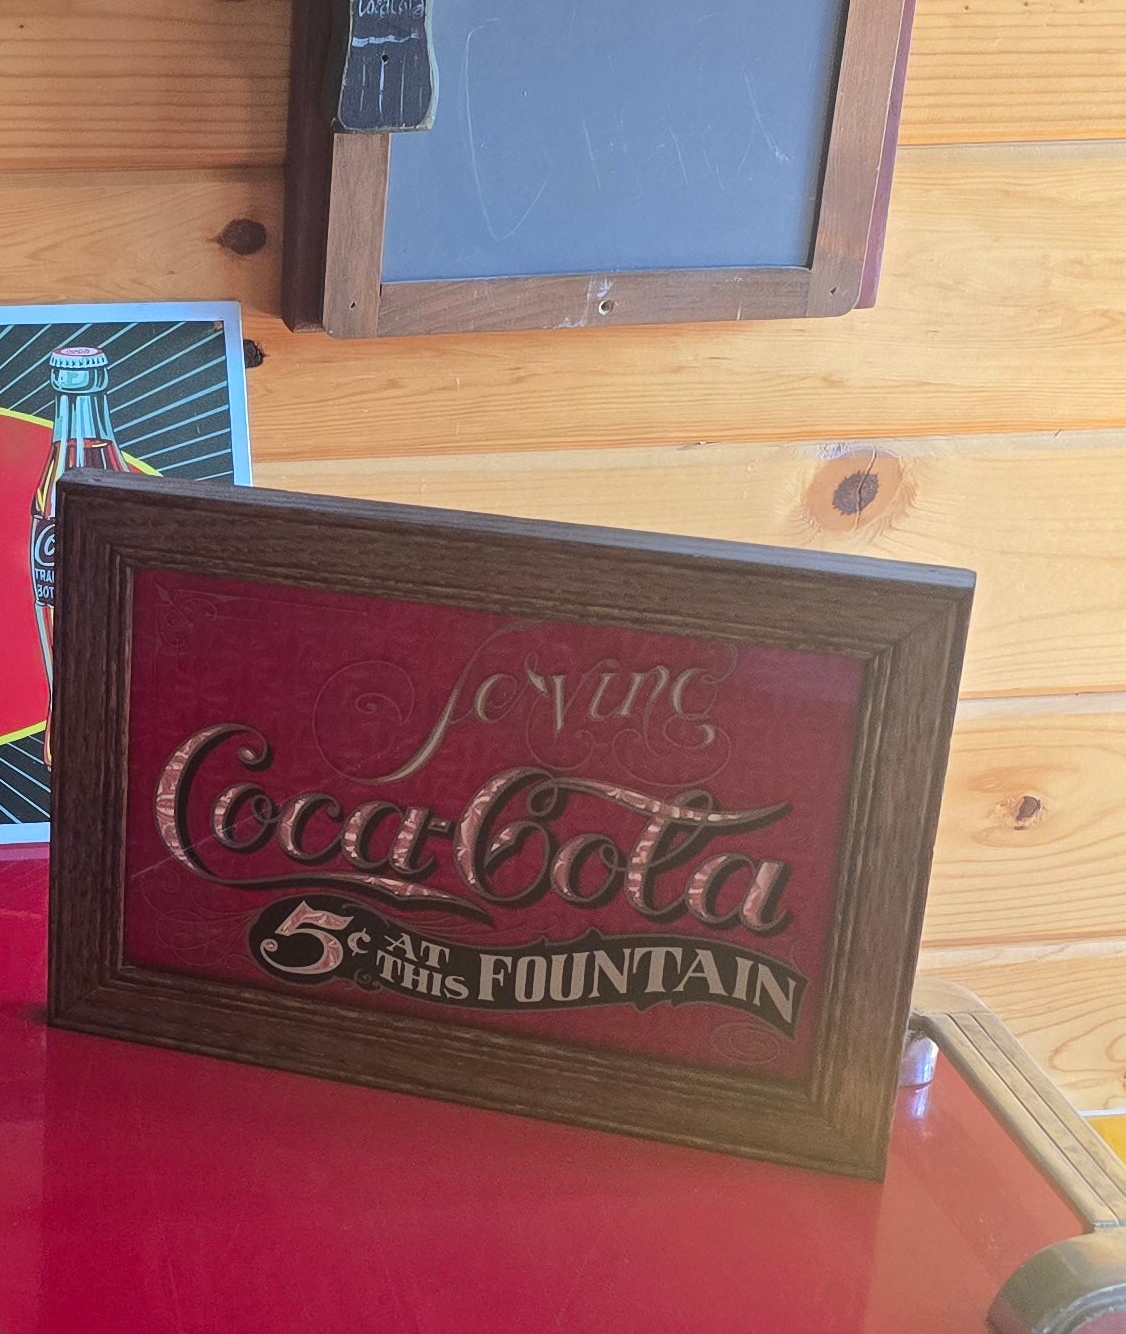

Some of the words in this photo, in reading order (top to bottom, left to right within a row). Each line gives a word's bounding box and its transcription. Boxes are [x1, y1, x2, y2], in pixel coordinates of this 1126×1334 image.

[155, 721, 793, 935] Coca-Cola
[375, 949, 470, 1002] THIS
[384, 931, 451, 967] AT
[476, 945, 797, 1025] FOUNTAIN
